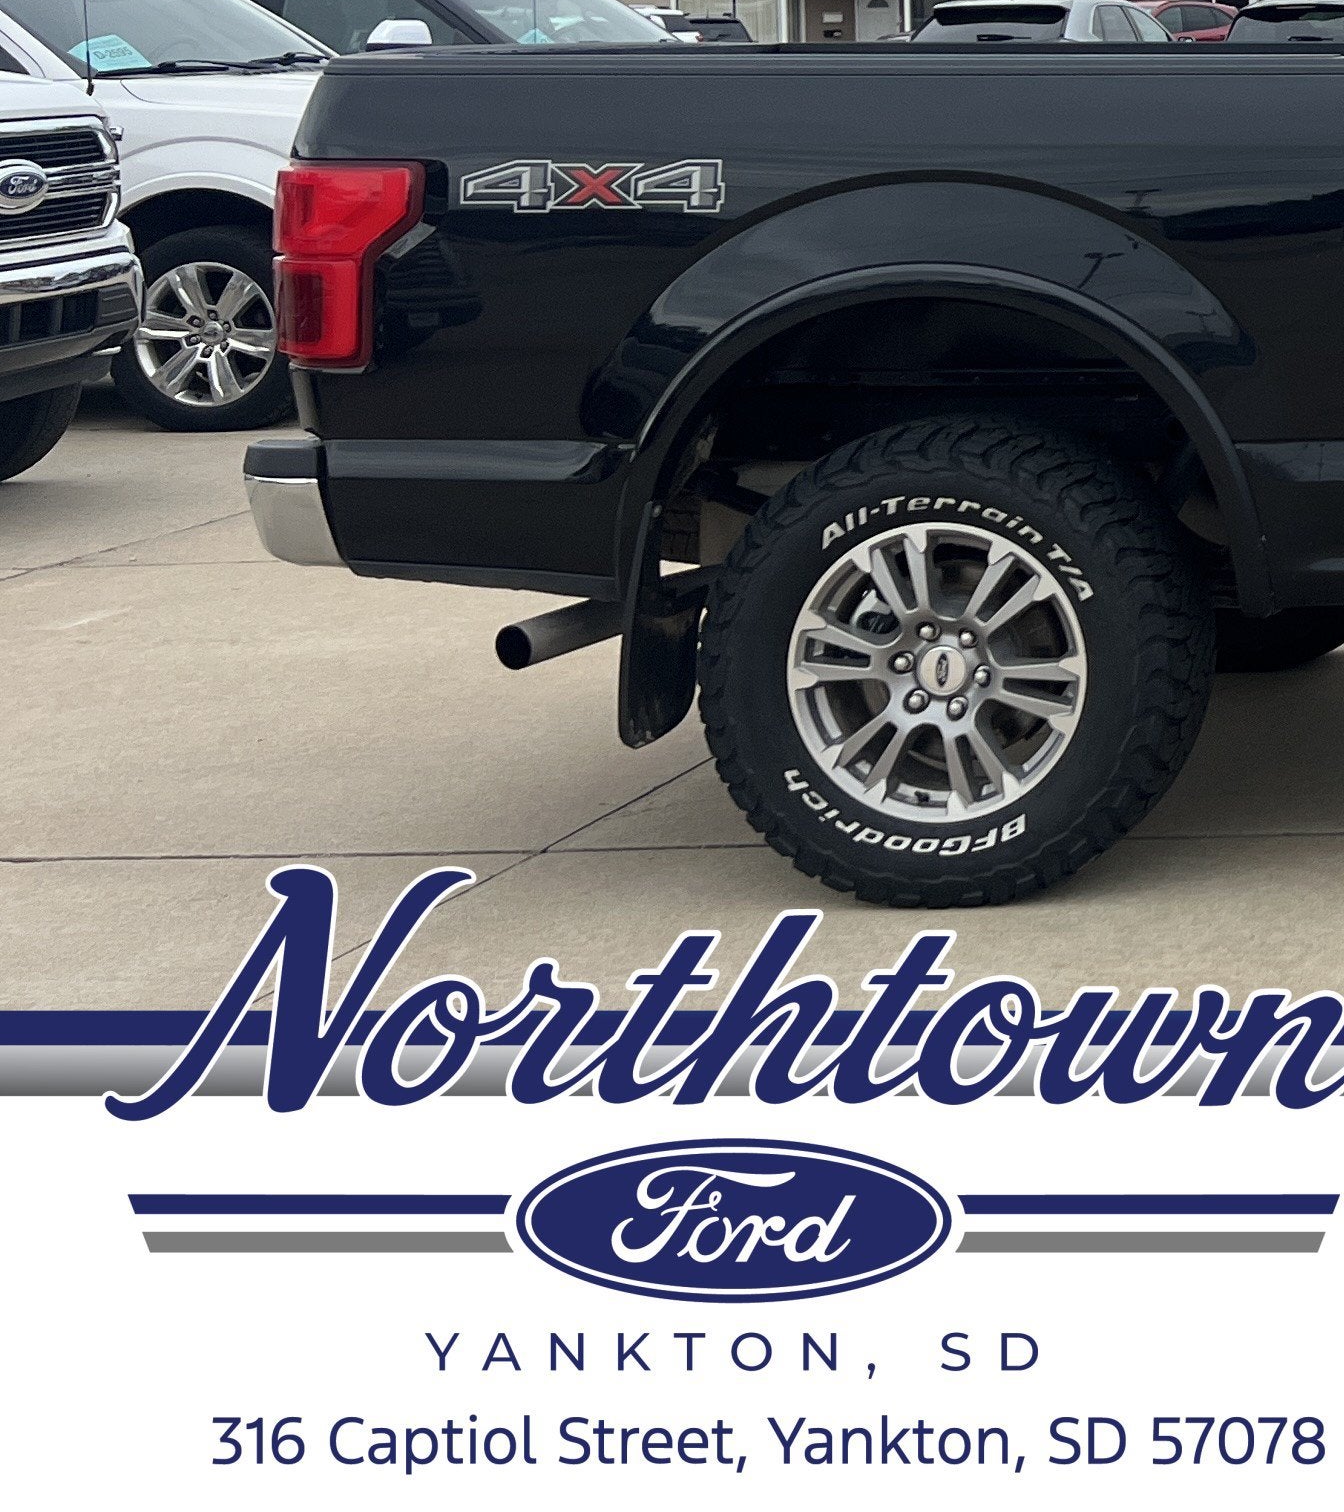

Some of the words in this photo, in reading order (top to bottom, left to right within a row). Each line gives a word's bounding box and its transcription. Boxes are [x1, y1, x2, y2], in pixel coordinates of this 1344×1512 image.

[8, 175, 38, 195] Ford
[822, 495, 1044, 550] All-Terrain
[1046, 543, 1094, 602] T/A
[783, 766, 1028, 857] BFGoodrich
